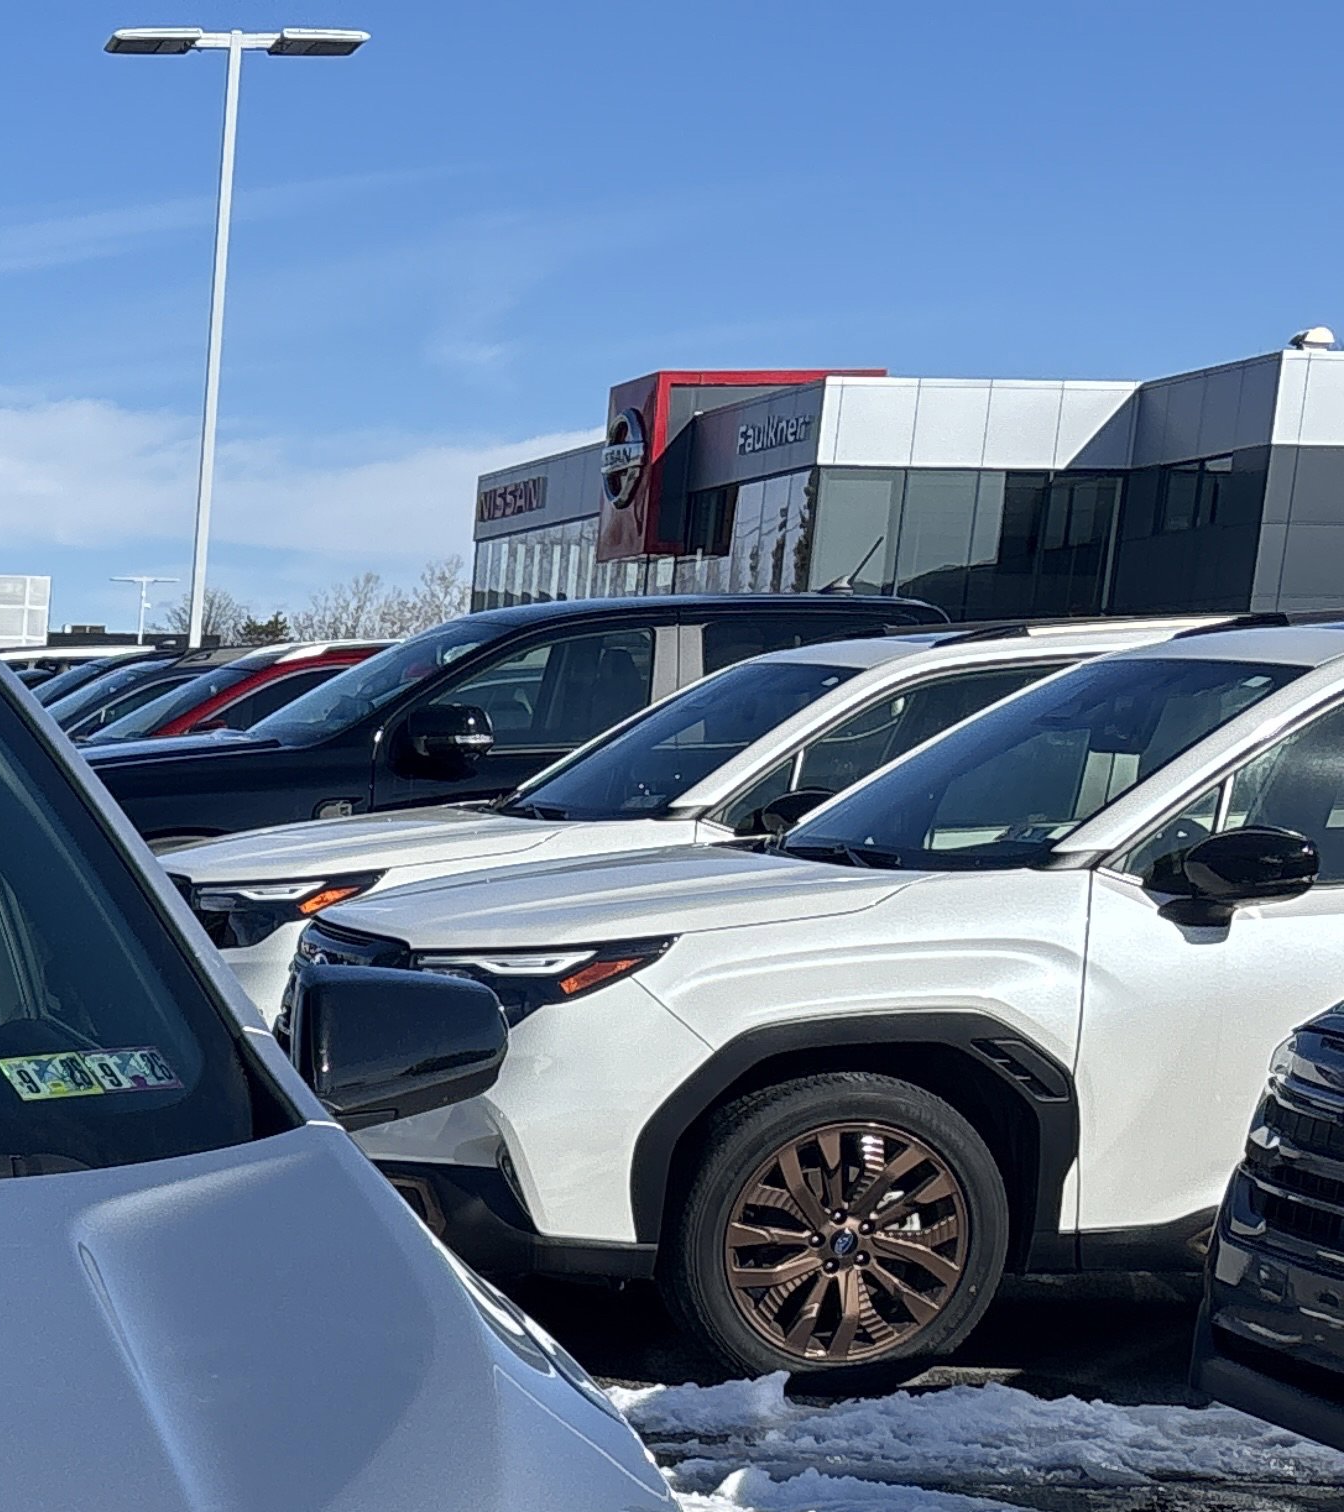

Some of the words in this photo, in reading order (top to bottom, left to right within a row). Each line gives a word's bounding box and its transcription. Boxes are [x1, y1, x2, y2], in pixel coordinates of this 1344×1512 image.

[477, 476, 547, 522] NISSAN
[16, 1069, 41, 1093] 9
[97, 1062, 123, 1087] 9
